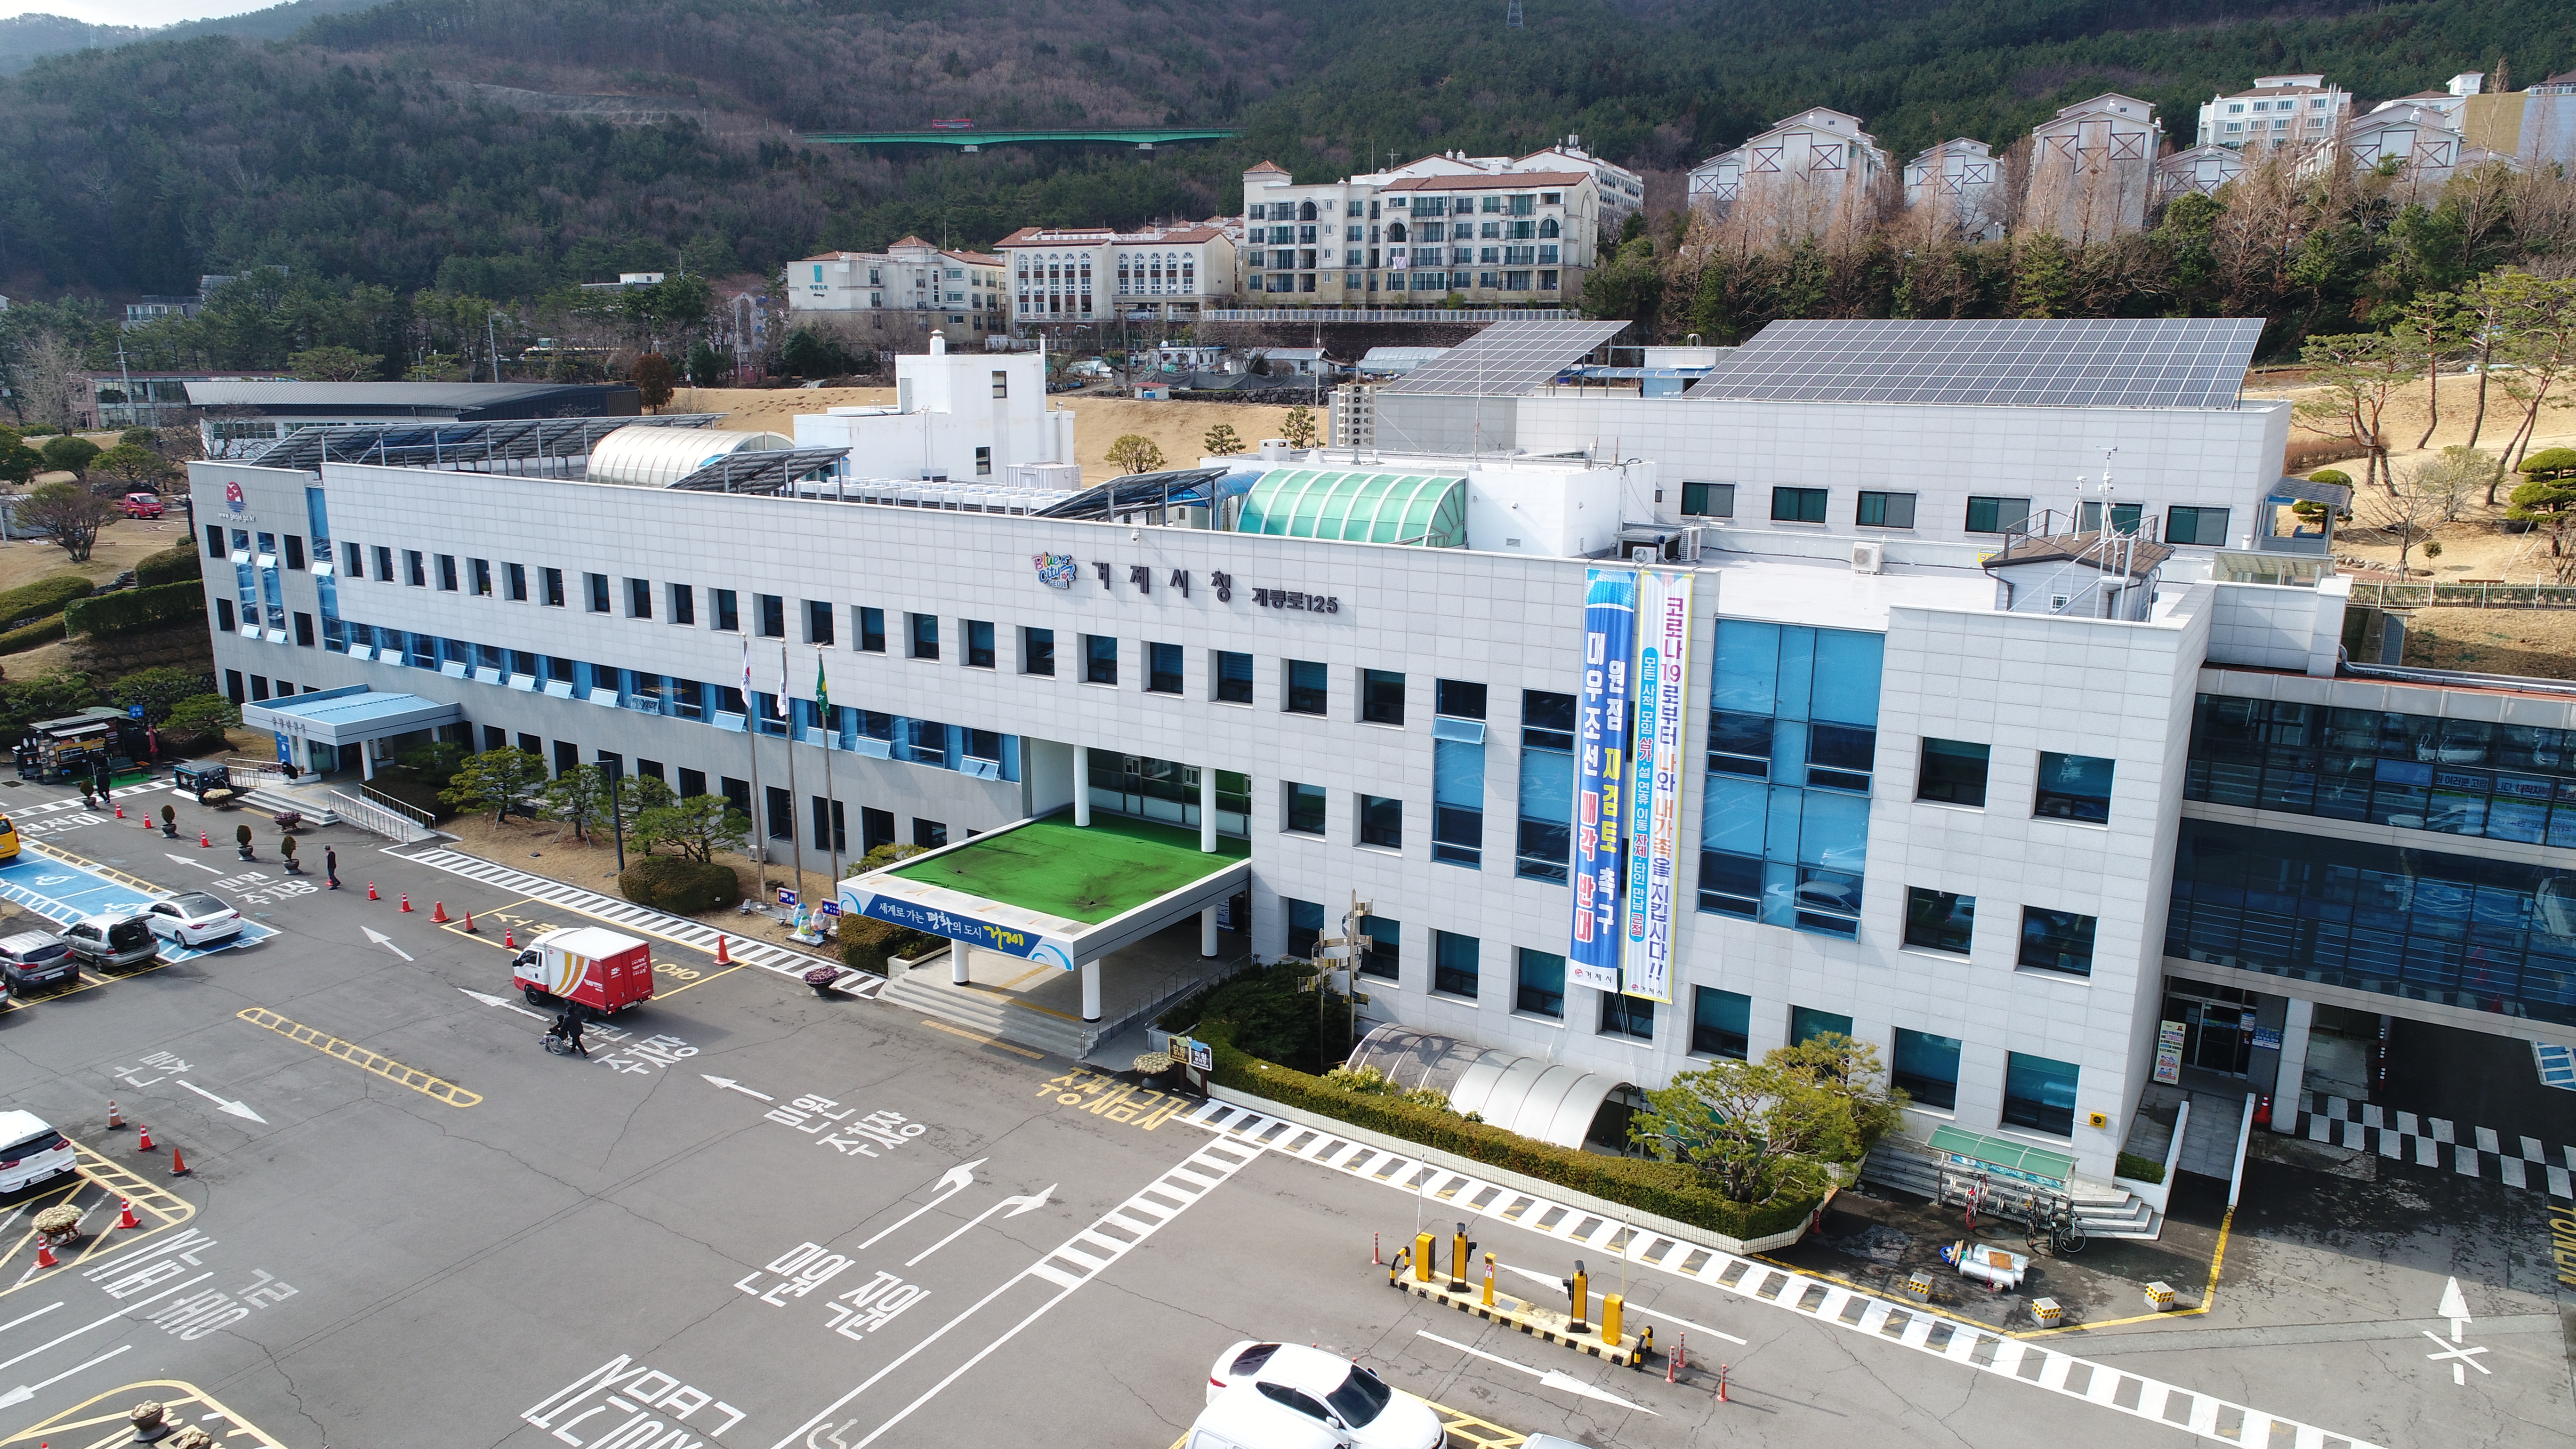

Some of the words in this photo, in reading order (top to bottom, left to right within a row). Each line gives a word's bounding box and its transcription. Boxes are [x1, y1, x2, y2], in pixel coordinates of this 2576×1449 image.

[1032, 553, 1060, 570] Blue
[1039, 566, 1060, 582] City
[1049, 580, 1067, 588] GEOJE
[1092, 562, 1231, 602] 거제시청
[1643, 657, 1656, 682] 모든
[1583, 632, 1606, 777] 대우조선
[1606, 660, 1626, 732] 원점
[1642, 684, 1655, 708] 사적
[1641, 711, 1653, 735] 모임
[1656, 752, 1676, 793] 나와
[1600, 747, 1621, 853] 재검토
[1636, 781, 1650, 805] 연휴
[15, 812, 109, 837] 천천히
[1579, 789, 1599, 862] 매각
[1636, 807, 1649, 831] 이동
[211, 871, 279, 892] 민원
[235, 880, 319, 904] 주차장
[1574, 872, 1594, 943] 반대
[1597, 867, 1615, 935] 촉구
[1632, 887, 1645, 911] 만남
[878, 902, 905, 918] 세계로
[906, 909, 925, 924] 가는
[926, 911, 961, 934] 평화의
[964, 925, 982, 940] 도시
[983, 925, 1024, 950] 거제
[1630, 913, 1644, 936] 근절
[1585, 971, 1612, 983] 거제시
[1641, 985, 1663, 996] 거제시
[592, 1034, 699, 1074] 주차장
[1173, 1044, 1185, 1054] 민원
[1194, 1051, 1207, 1061] 직원
[1036, 1067, 1191, 1131] 주정차금지
[764, 1093, 855, 1134] 민원
[815, 1110, 926, 1158] 주차장
[733, 1241, 856, 1307] 민원
[825, 1270, 932, 1341] 직원
